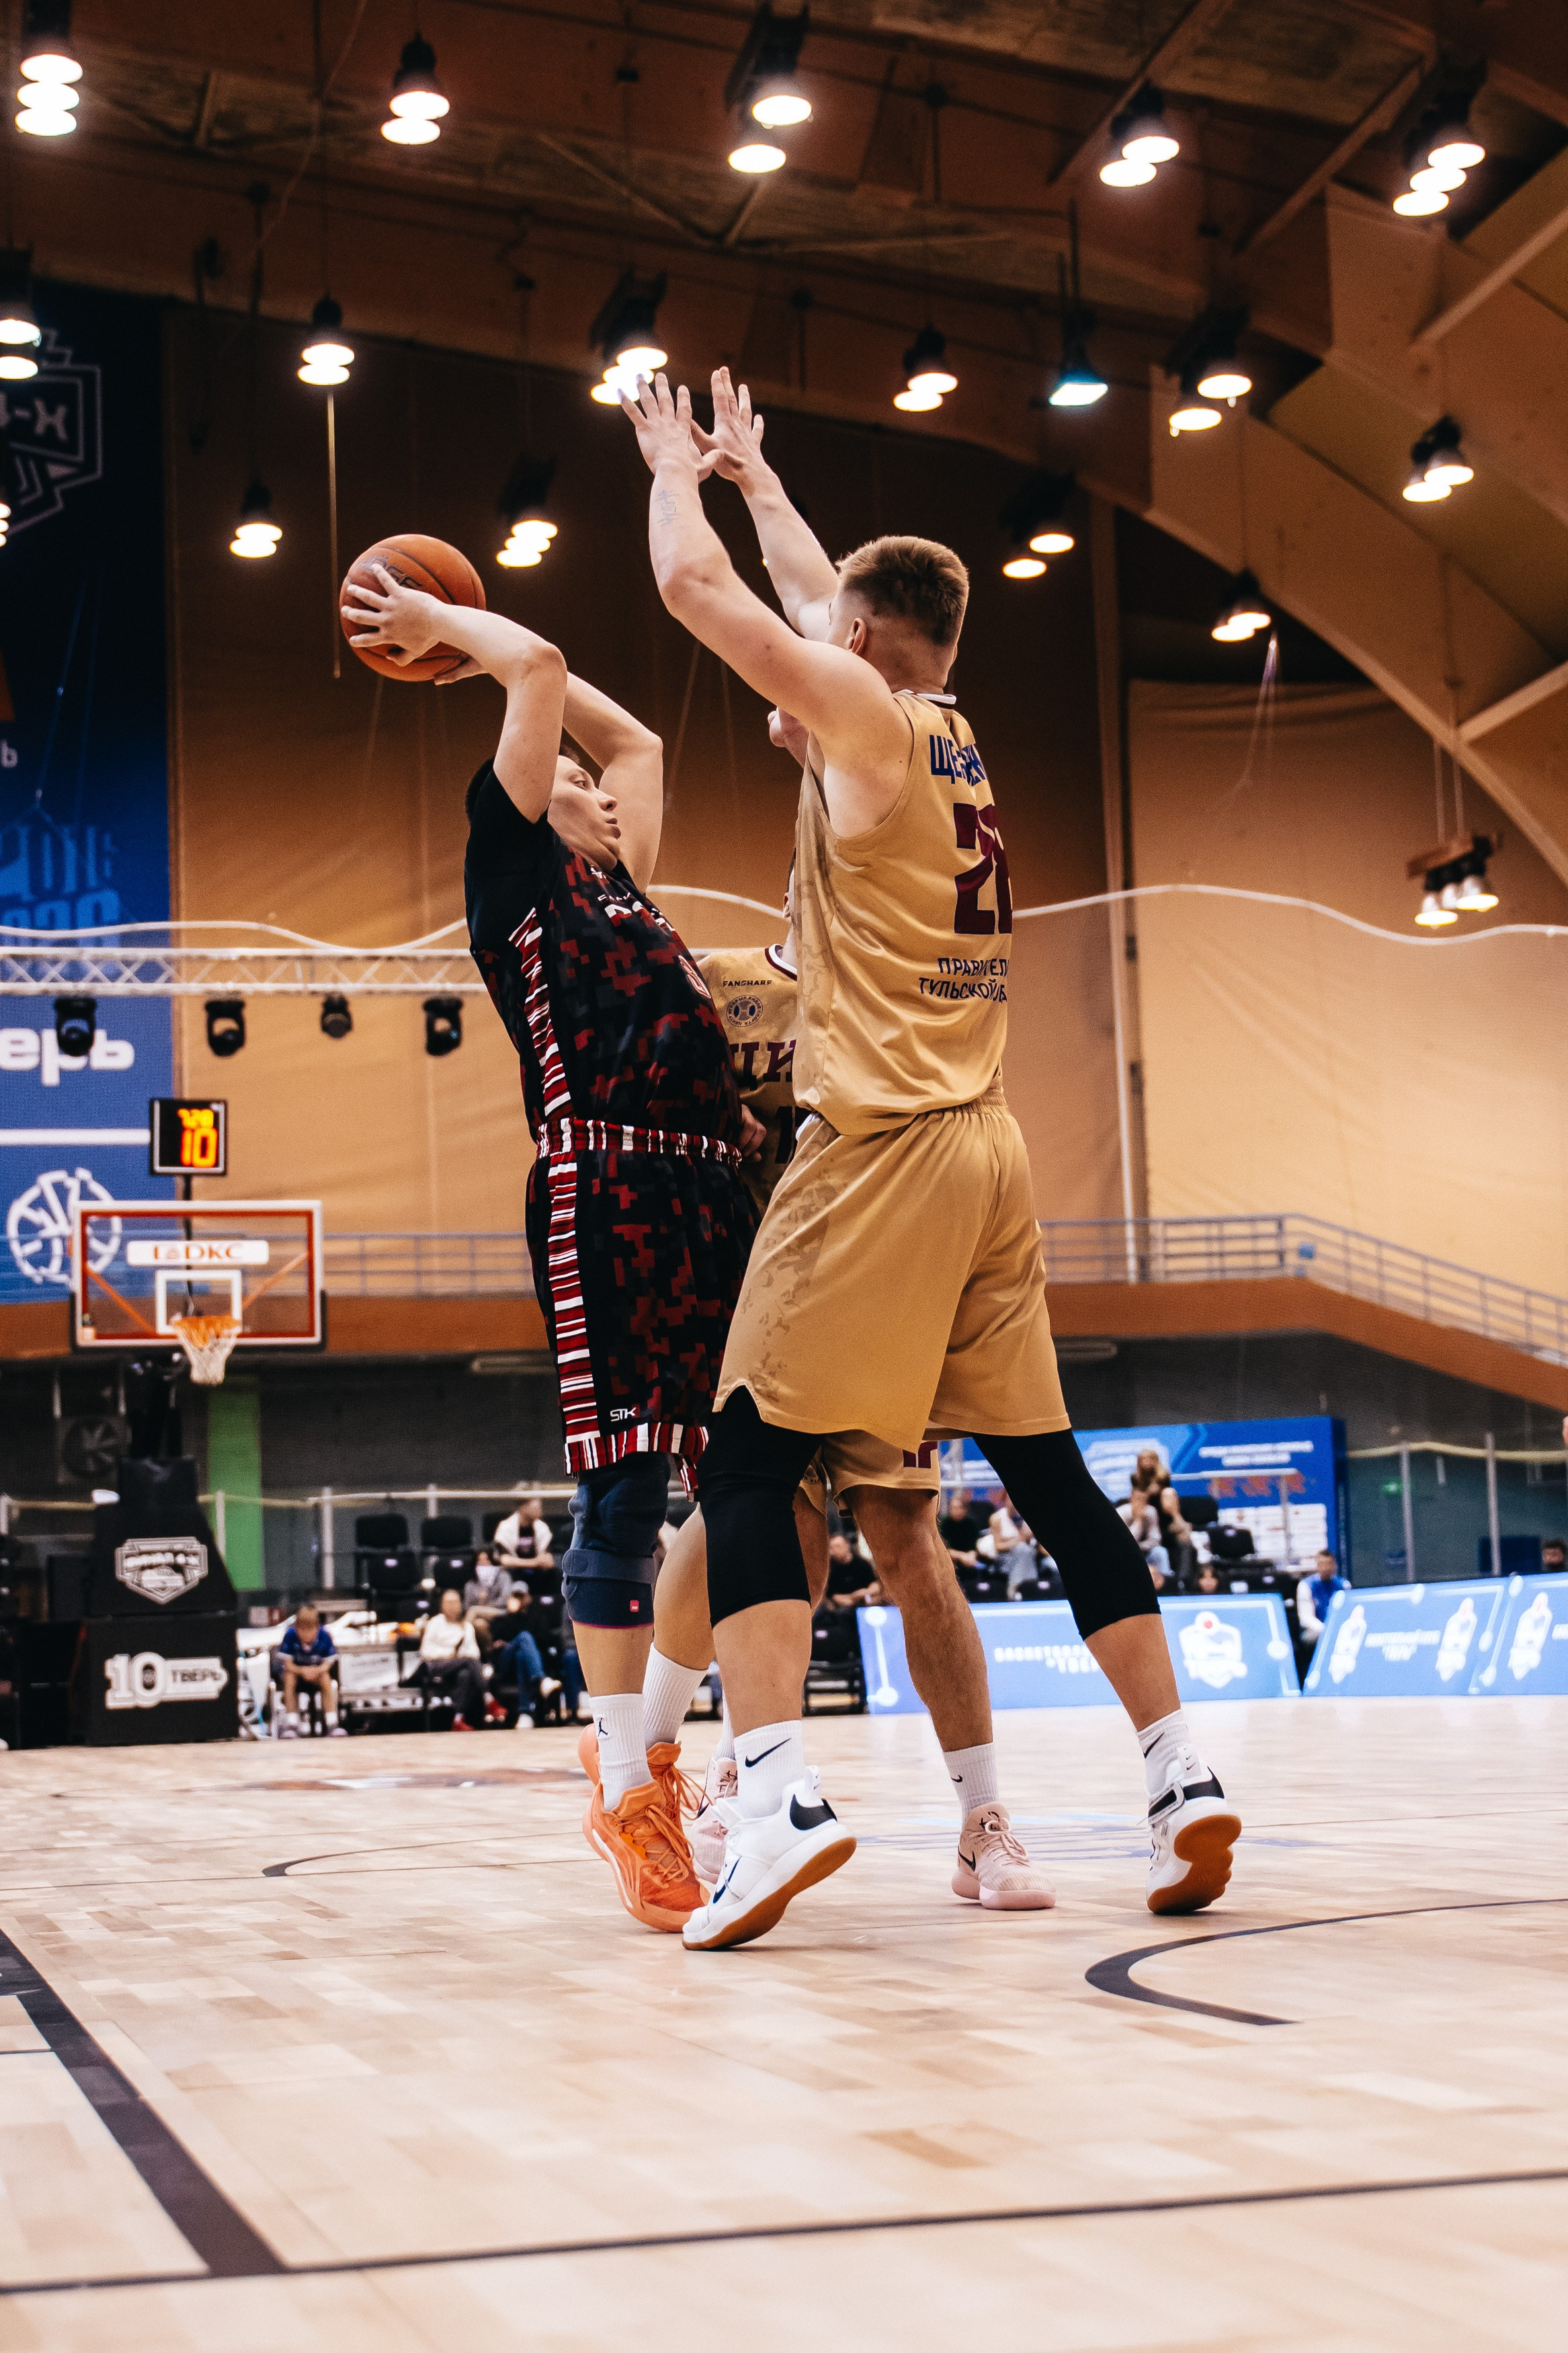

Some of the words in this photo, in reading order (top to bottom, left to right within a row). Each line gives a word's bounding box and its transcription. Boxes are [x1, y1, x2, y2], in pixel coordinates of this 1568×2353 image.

[919, 977, 997, 999] ТУЛЬСКОЙ
[180, 1127, 218, 1168] 10
[610, 1407, 637, 1422] STK
[104, 1652, 167, 1710] 10
